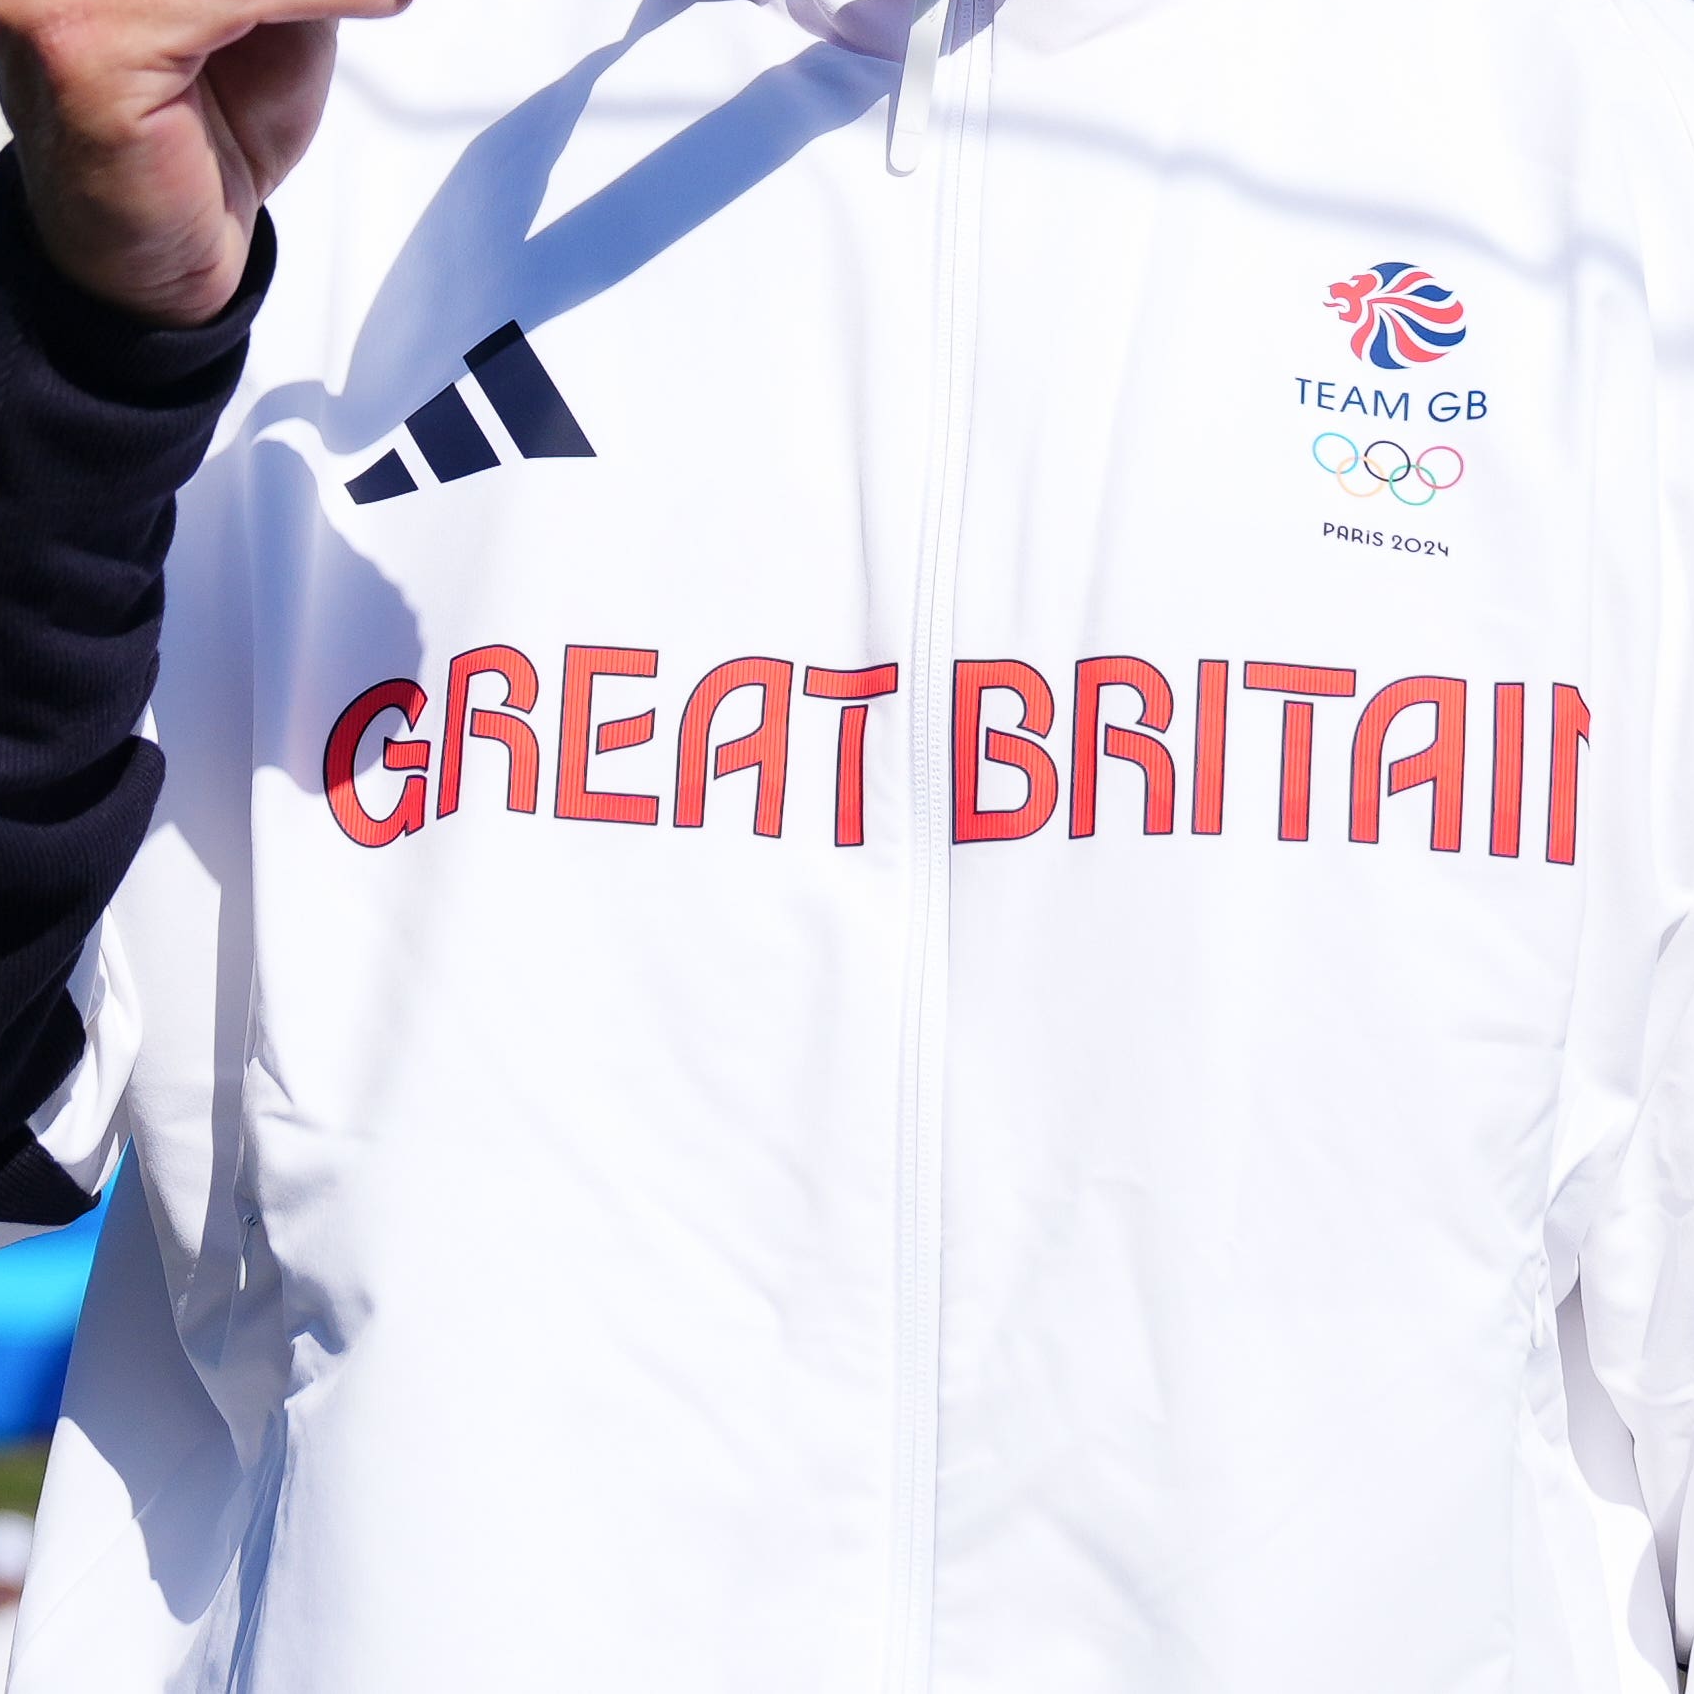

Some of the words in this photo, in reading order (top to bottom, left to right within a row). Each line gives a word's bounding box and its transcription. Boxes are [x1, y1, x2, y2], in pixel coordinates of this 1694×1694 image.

[1295, 377, 1410, 421] TEAM
[1428, 390, 1488, 422] GB
[1391, 535, 1449, 557] 2024
[323, 644, 899, 848] GREAT
